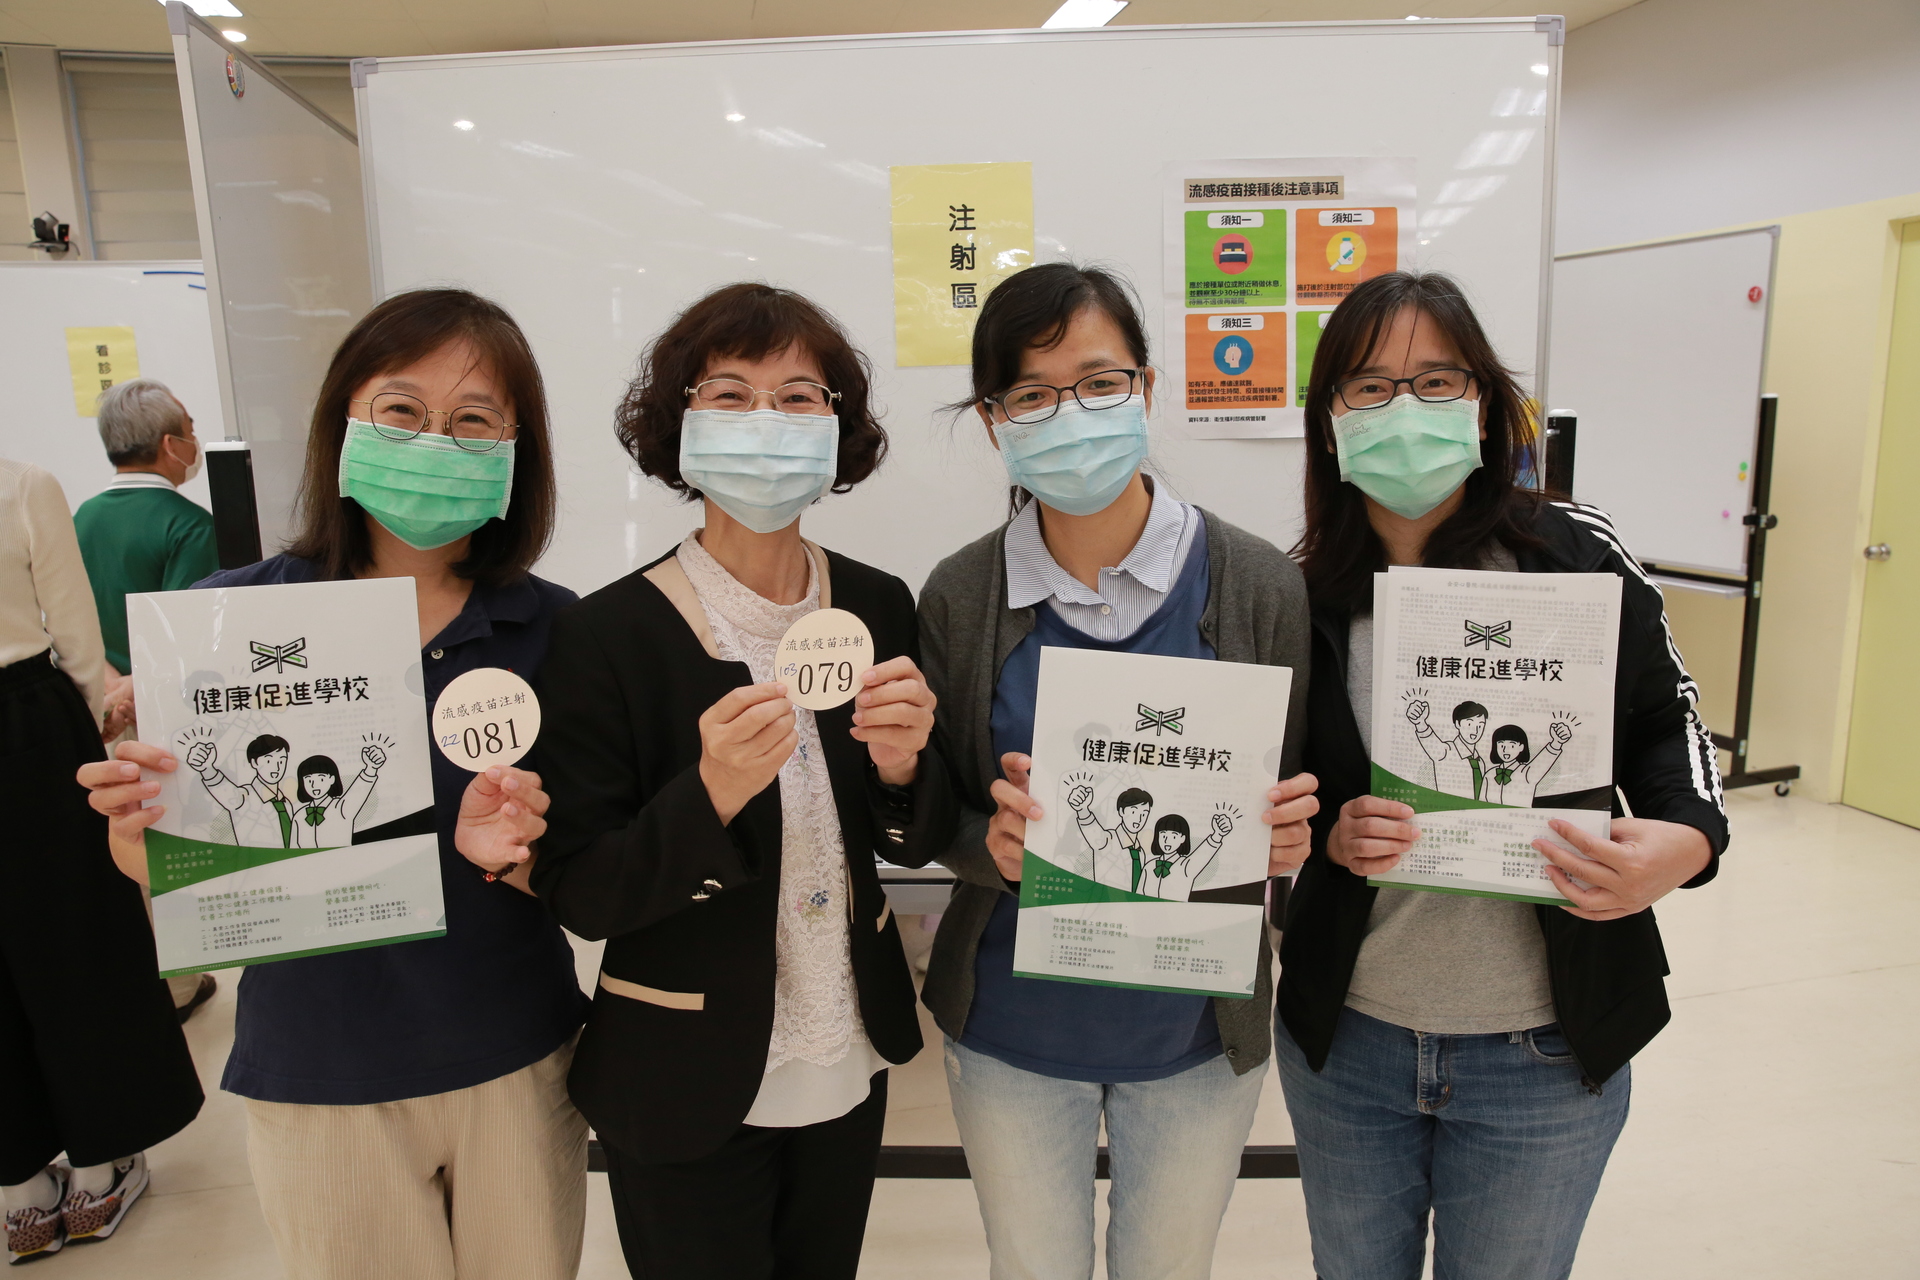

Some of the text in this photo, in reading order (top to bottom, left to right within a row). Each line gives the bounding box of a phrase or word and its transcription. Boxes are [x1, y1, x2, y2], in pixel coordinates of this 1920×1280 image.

[1188, 181, 1340, 198] 流感疫苗接種後注意事項
[1220, 214, 1252, 226] 須知一
[1331, 212, 1363, 224] 須知二
[949, 204, 977, 309] 注射區
[1221, 318, 1252, 328] 須知三
[785, 635, 865, 651] 流感疫苗注射
[798, 661, 853, 695] 079
[1416, 656, 1563, 682] 健康促進學校
[193, 675, 370, 715] 健康促進學校
[441, 692, 526, 720] 流感疫苗注射
[463, 717, 522, 759] 081
[1082, 738, 1232, 772] 健康促進學校
